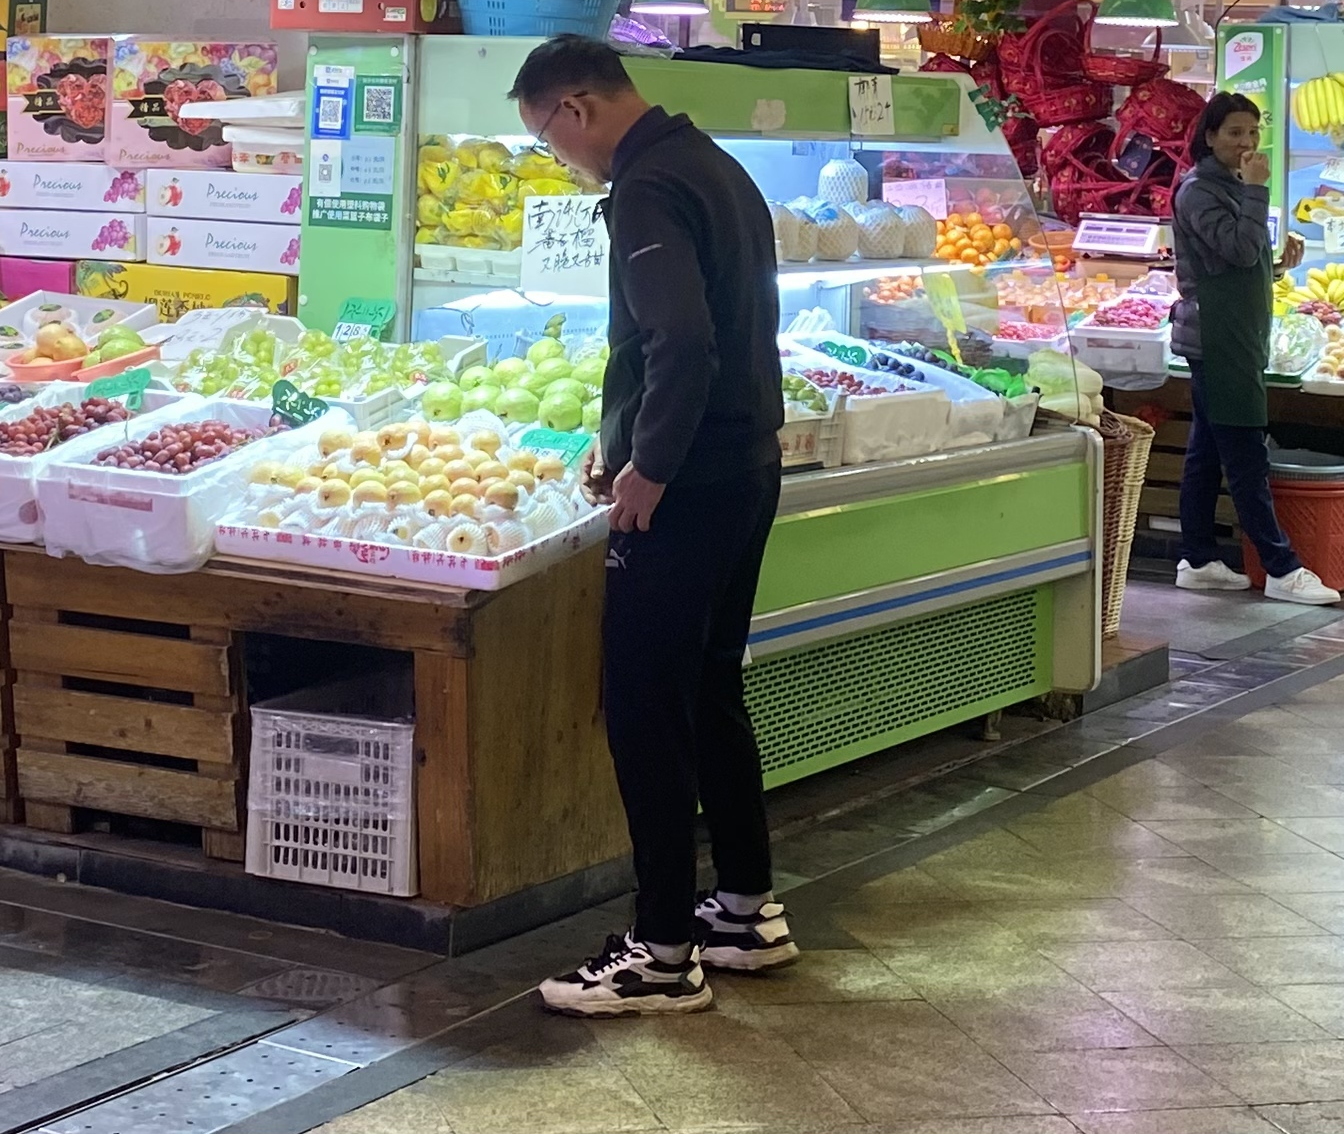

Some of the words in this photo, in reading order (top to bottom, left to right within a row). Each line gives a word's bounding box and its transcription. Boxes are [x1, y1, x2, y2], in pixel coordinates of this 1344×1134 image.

[17, 142, 65, 154] Precious
[120, 149, 170, 161] Precious
[33, 174, 83, 191] Precious
[206, 183, 259, 202] Precious
[19, 223, 70, 240] Precious
[205, 232, 257, 252] Precious
